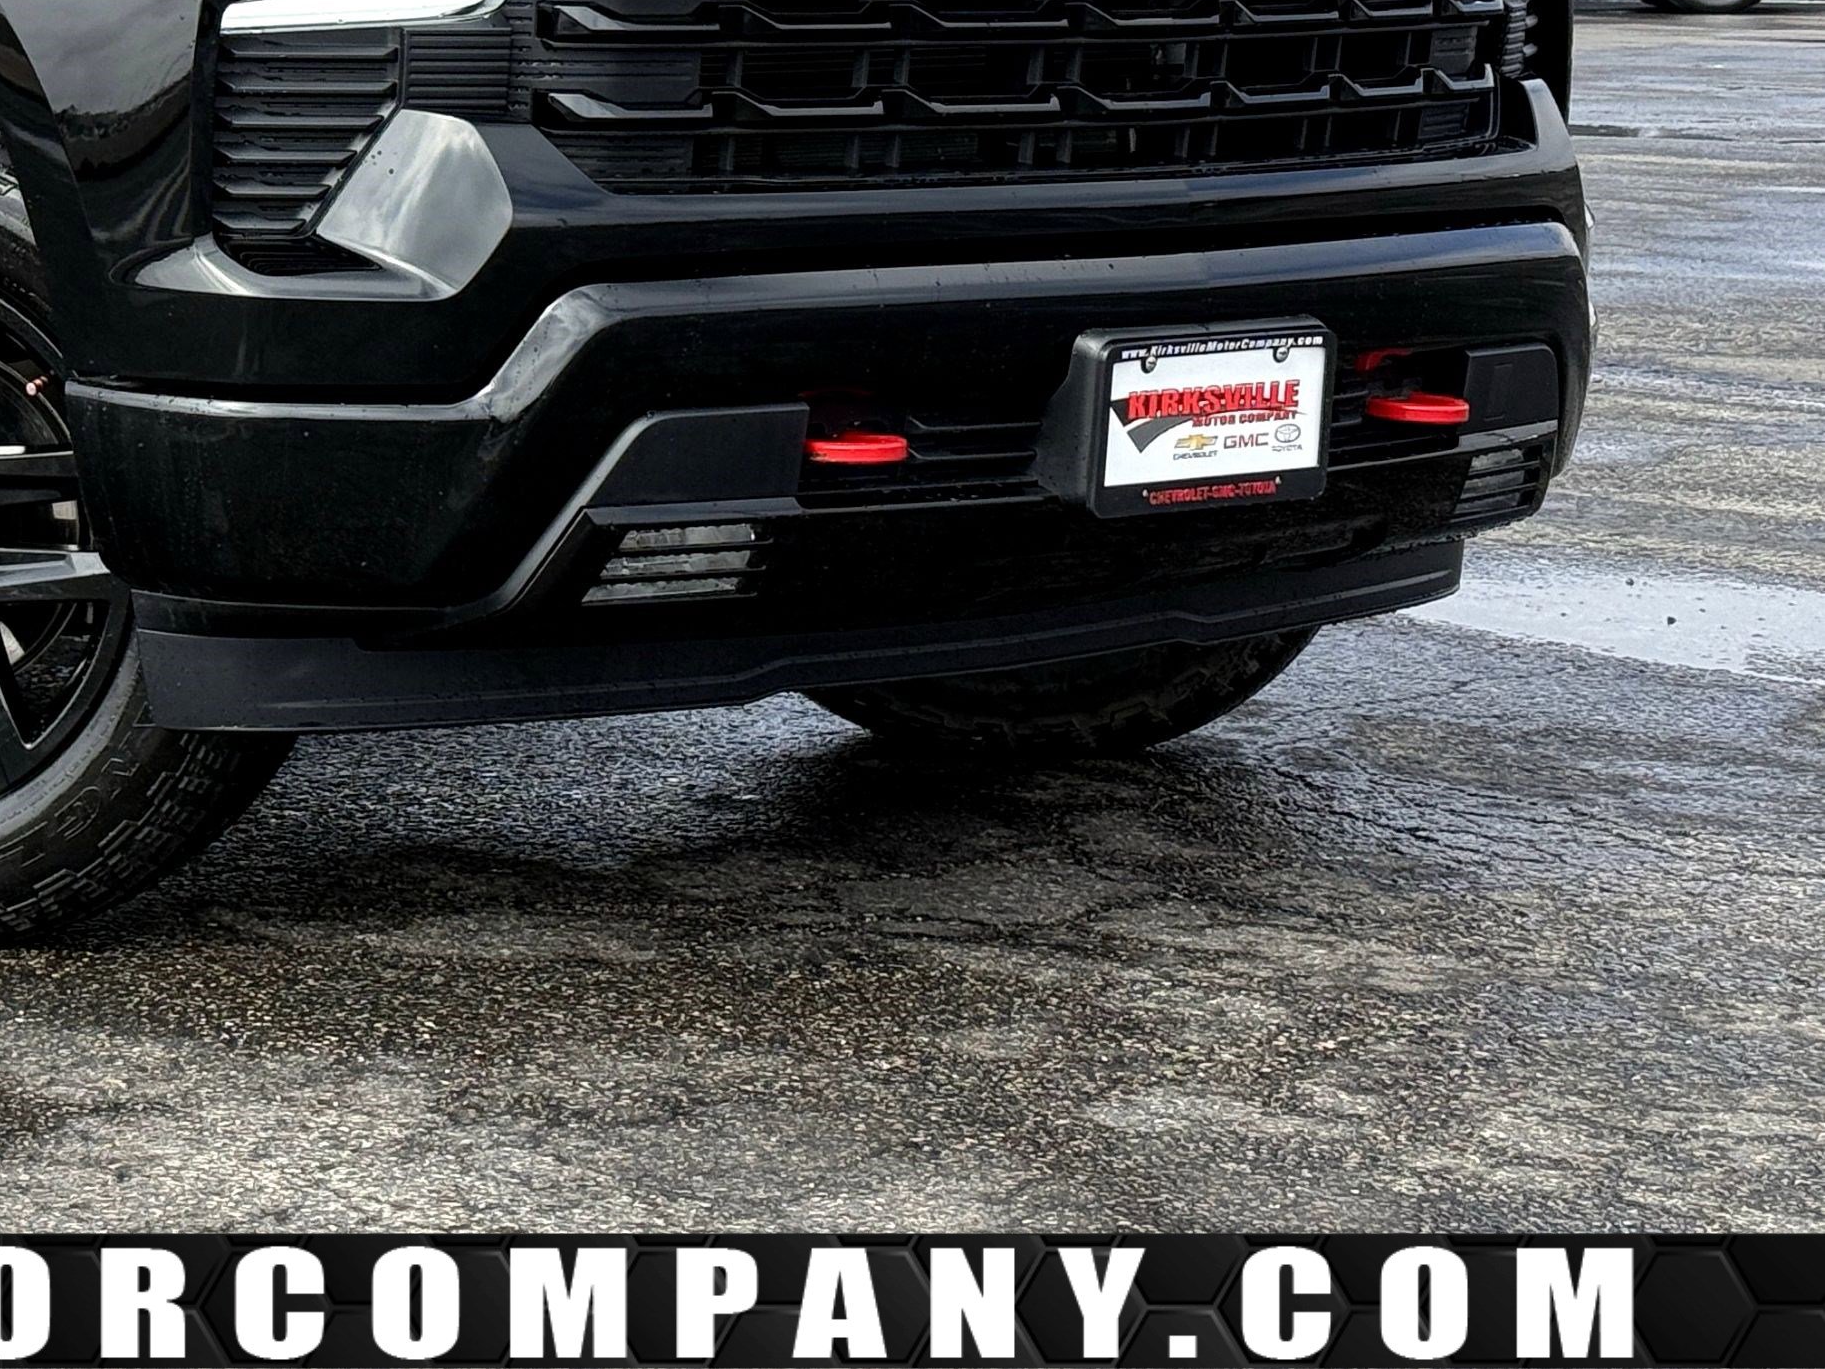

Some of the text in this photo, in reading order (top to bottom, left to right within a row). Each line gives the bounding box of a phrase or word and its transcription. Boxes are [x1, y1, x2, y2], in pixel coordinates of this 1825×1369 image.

[1127, 379, 1301, 421] KIRKSVILLE
[1192, 410, 1298, 427] MOTOR COMPANY
[1223, 432, 1269, 449] GMC
